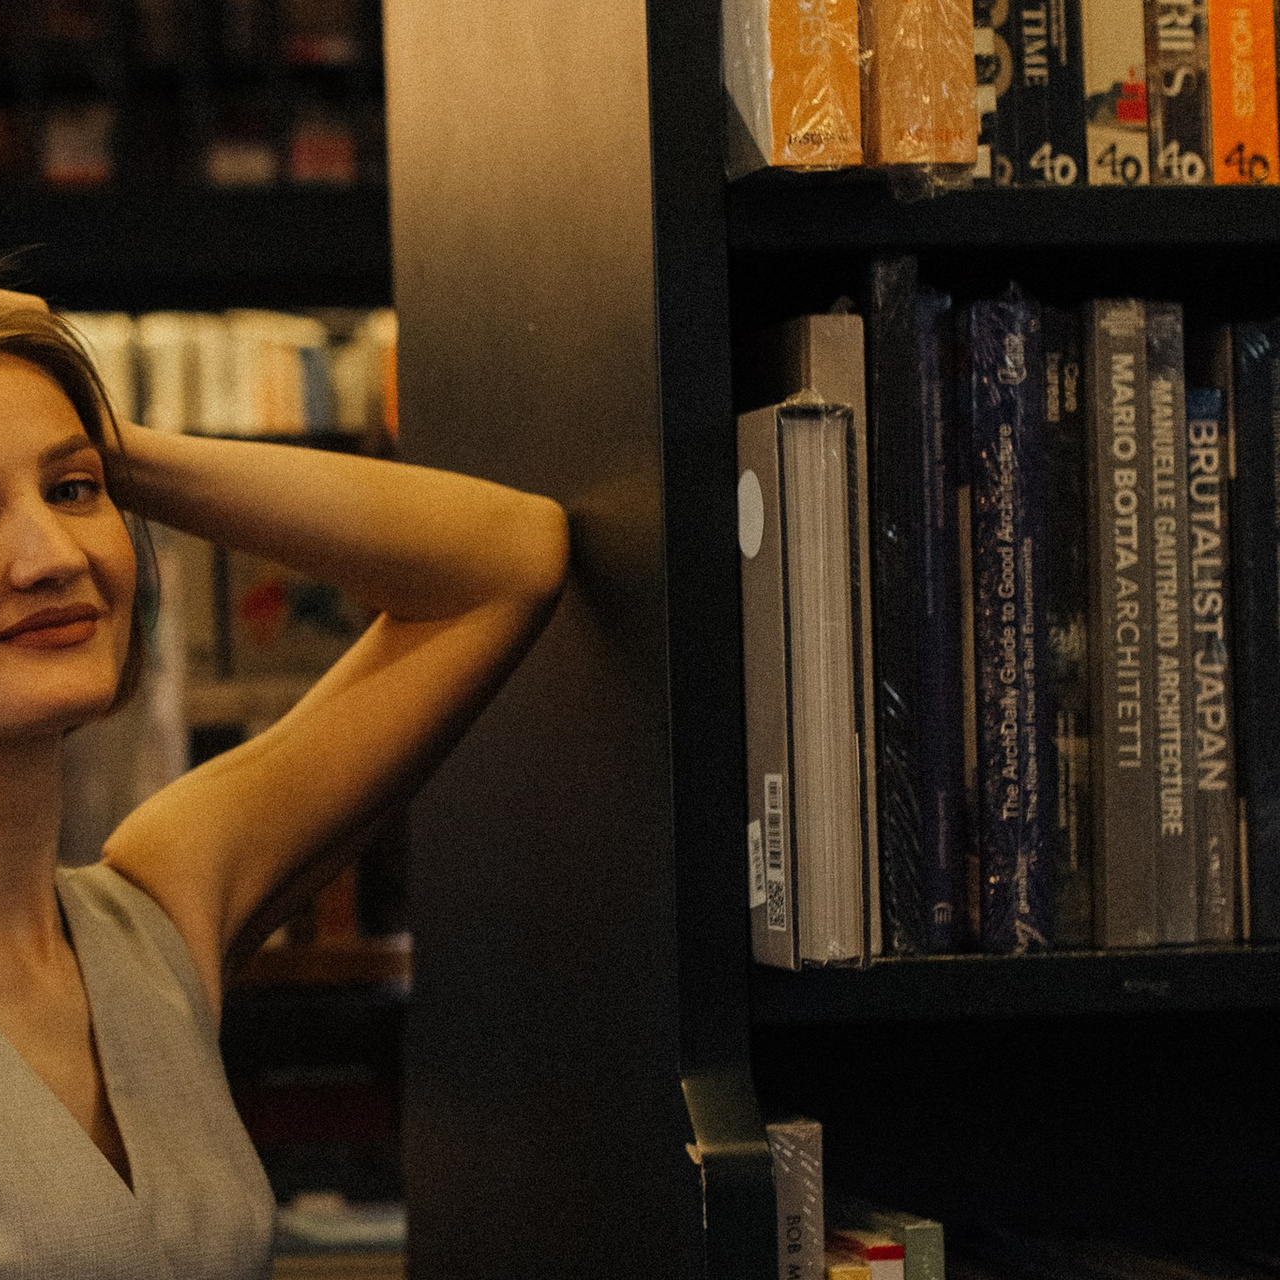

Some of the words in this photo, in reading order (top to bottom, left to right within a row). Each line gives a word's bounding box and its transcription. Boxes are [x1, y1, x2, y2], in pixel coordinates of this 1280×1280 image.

[1022, 4, 1050, 88] TIME
[1229, 6, 1256, 120] HOUSES
[1029, 140, 1079, 187] 40
[1095, 141, 1142, 186] 40
[1156, 138, 1207, 186] 40
[1223, 141, 1270, 186] 40
[1111, 352, 1137, 461] MARIO
[1150, 379, 1176, 510] MANUELLE
[995, 423, 1015, 543] Architecture
[1113, 467, 1139, 571] BOTTA
[1188, 418, 1225, 641] BRUTALIST
[996, 546, 1016, 599] Good
[1000, 601, 1017, 623] to
[1153, 515, 1180, 648] GAUTRAND
[998, 626, 1018, 685] Guide
[1115, 576, 1142, 768] ARCHITETTI
[999, 686, 1021, 780] ArchDaily
[1157, 654, 1184, 836] ARCHITECTURE
[1193, 649, 1229, 790] JAPAN
[1001, 785, 1020, 822] The
[785, 1213, 804, 1255] BOB
